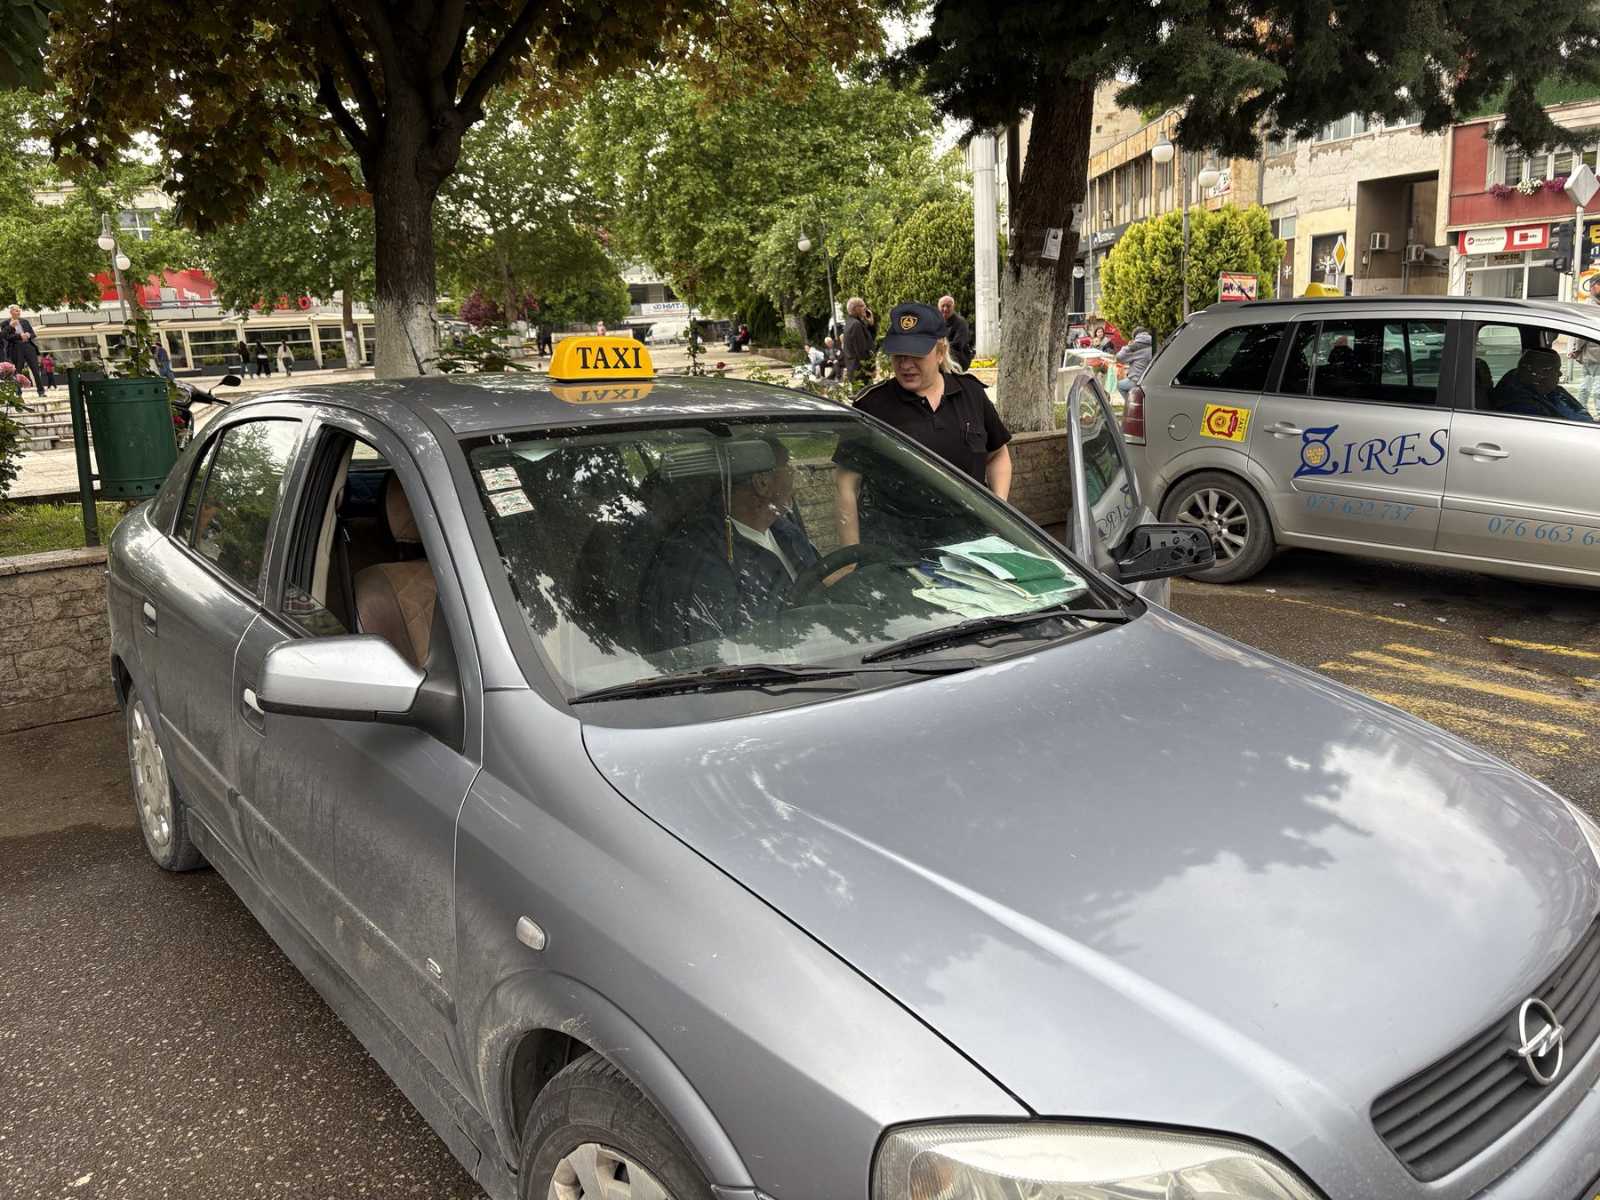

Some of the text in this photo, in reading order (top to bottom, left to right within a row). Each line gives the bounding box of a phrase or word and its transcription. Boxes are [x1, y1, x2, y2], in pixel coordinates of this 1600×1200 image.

[576, 346, 643, 369] TAXI
[1293, 423, 1448, 479] ZIRES
[1488, 516, 1530, 537] 076
[1535, 523, 1574, 543] 663
